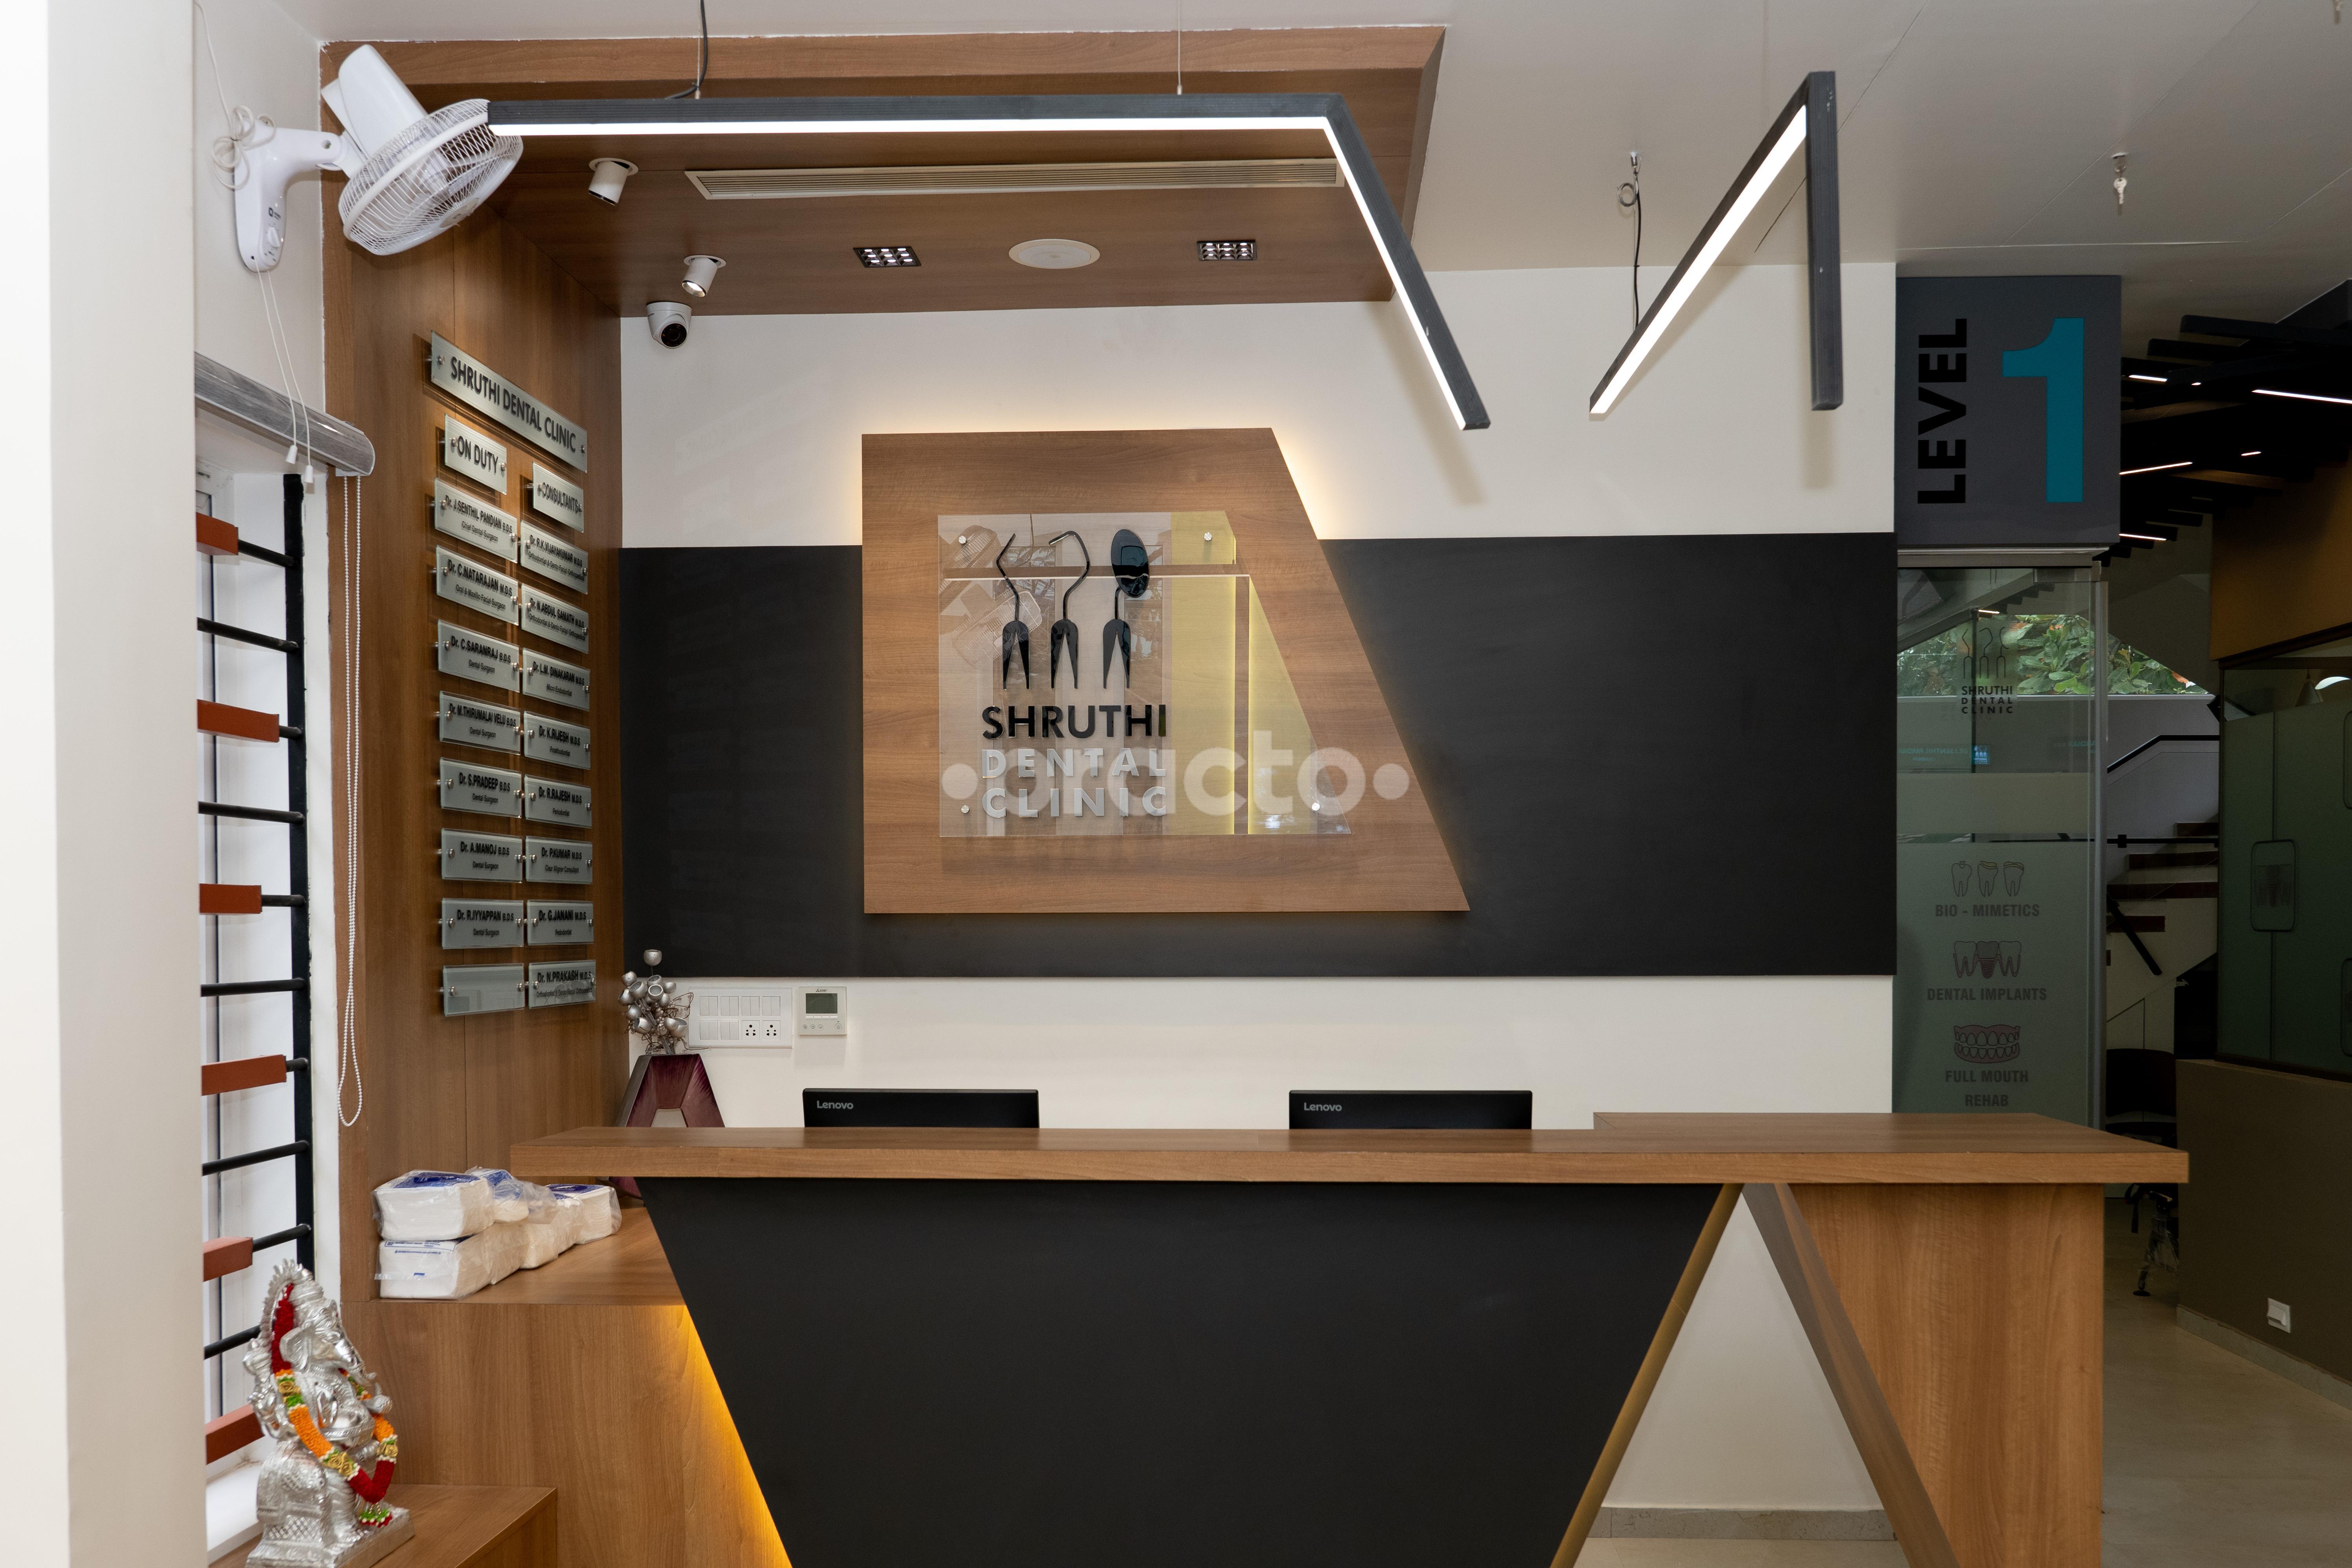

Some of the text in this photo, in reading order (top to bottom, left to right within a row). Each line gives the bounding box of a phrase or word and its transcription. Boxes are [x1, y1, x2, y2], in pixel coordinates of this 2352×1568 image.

[451, 356, 576, 452] SHRUTHI DENTAL CLINIC
[1918, 318, 1967, 504] LEVEL
[2002, 317, 2085, 503] 1
[457, 436, 498, 473] ON DUTY
[542, 482, 578, 514] CONSULTANTS
[454, 499, 479, 519] J.SENTHIL
[480, 510, 502, 529] PANDIAN
[503, 523, 512, 534] B.D.S
[462, 521, 498, 542] Chief Dental Surgeon
[448, 559, 512, 596] Dr. C.NATARAJAN M.D.S
[456, 584, 464, 593] Oral
[468, 589, 481, 600] Maxillo
[481, 594, 491, 604] Facial
[492, 598, 506, 610] Surgeon
[537, 601, 556, 617] N.ABDUL
[557, 609, 575, 625] SAMATH
[451, 635, 511, 663] Dr. C.SARANRAJ B.D.S
[468, 659, 495, 673] Dental Surgeon
[550, 666, 575, 683] DINAKARAN
[1962, 686, 2012, 695] SHRUTHI
[457, 705, 493, 722] M.THIRUMALAI
[494, 713, 506, 725] VELU
[507, 717, 516, 727] B.D.S
[982, 704, 1167, 740] SHRUTHI
[470, 727, 496, 739] Dental Surgeon
[547, 728, 569, 743] K.RIJESH
[982, 748, 1167, 778] DENTAL
[468, 773, 499, 789] S.PRADEEP
[500, 781, 510, 792] B.D.S
[472, 793, 499, 804] Dental Surgeon
[547, 788, 571, 802] R.RAJESH
[982, 786, 1167, 818] CLINIC
[553, 808, 570, 816] Periodontist
[461, 841, 510, 856] Dr. A.MANOJ B.D.S
[550, 848, 571, 859] P.KUMAR
[485, 862, 499, 871] Surgeon
[457, 909, 465, 920] Dr.
[467, 910, 501, 921] R.IYYAPPAN
[548, 910, 574, 921] G.JANANI
[575, 912, 586, 920] M.D.S
[1935, 904, 1958, 916] BIO
[1973, 904, 2040, 916] MIMETICS
[485, 929, 500, 937] Surgeon
[546, 970, 579, 982] N.PRAKASH
[580, 971, 592, 980] M.D.S
[1927, 988, 2047, 1000] DENTAL IMPLANTS
[1945, 1070, 2029, 1082] FULL MOUTH
[817, 1100, 854, 1109] Lenovo
[1304, 1102, 1342, 1112] Lenovo
[1965, 1094, 2009, 1107] REHAB
